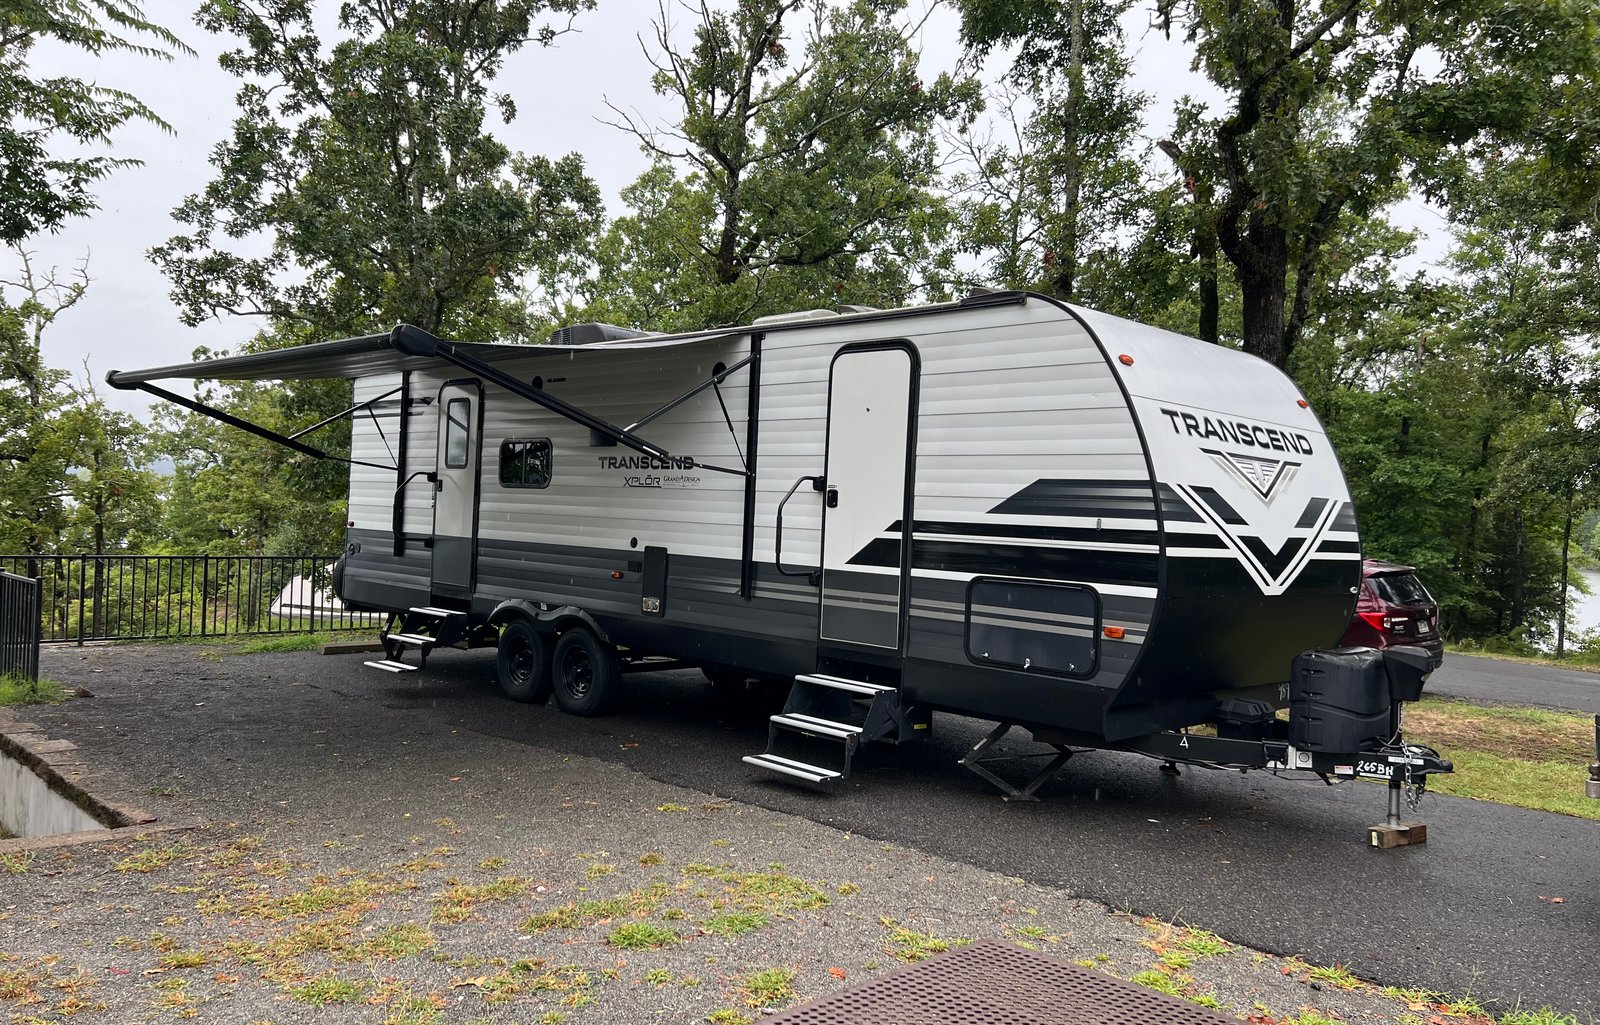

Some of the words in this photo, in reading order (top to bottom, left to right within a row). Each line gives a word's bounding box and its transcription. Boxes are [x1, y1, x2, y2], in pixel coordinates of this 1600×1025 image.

[1160, 407, 1313, 455] TRANSCEND
[598, 456, 694, 470] TRANSCEND
[1356, 760, 1394, 776] 265BH
